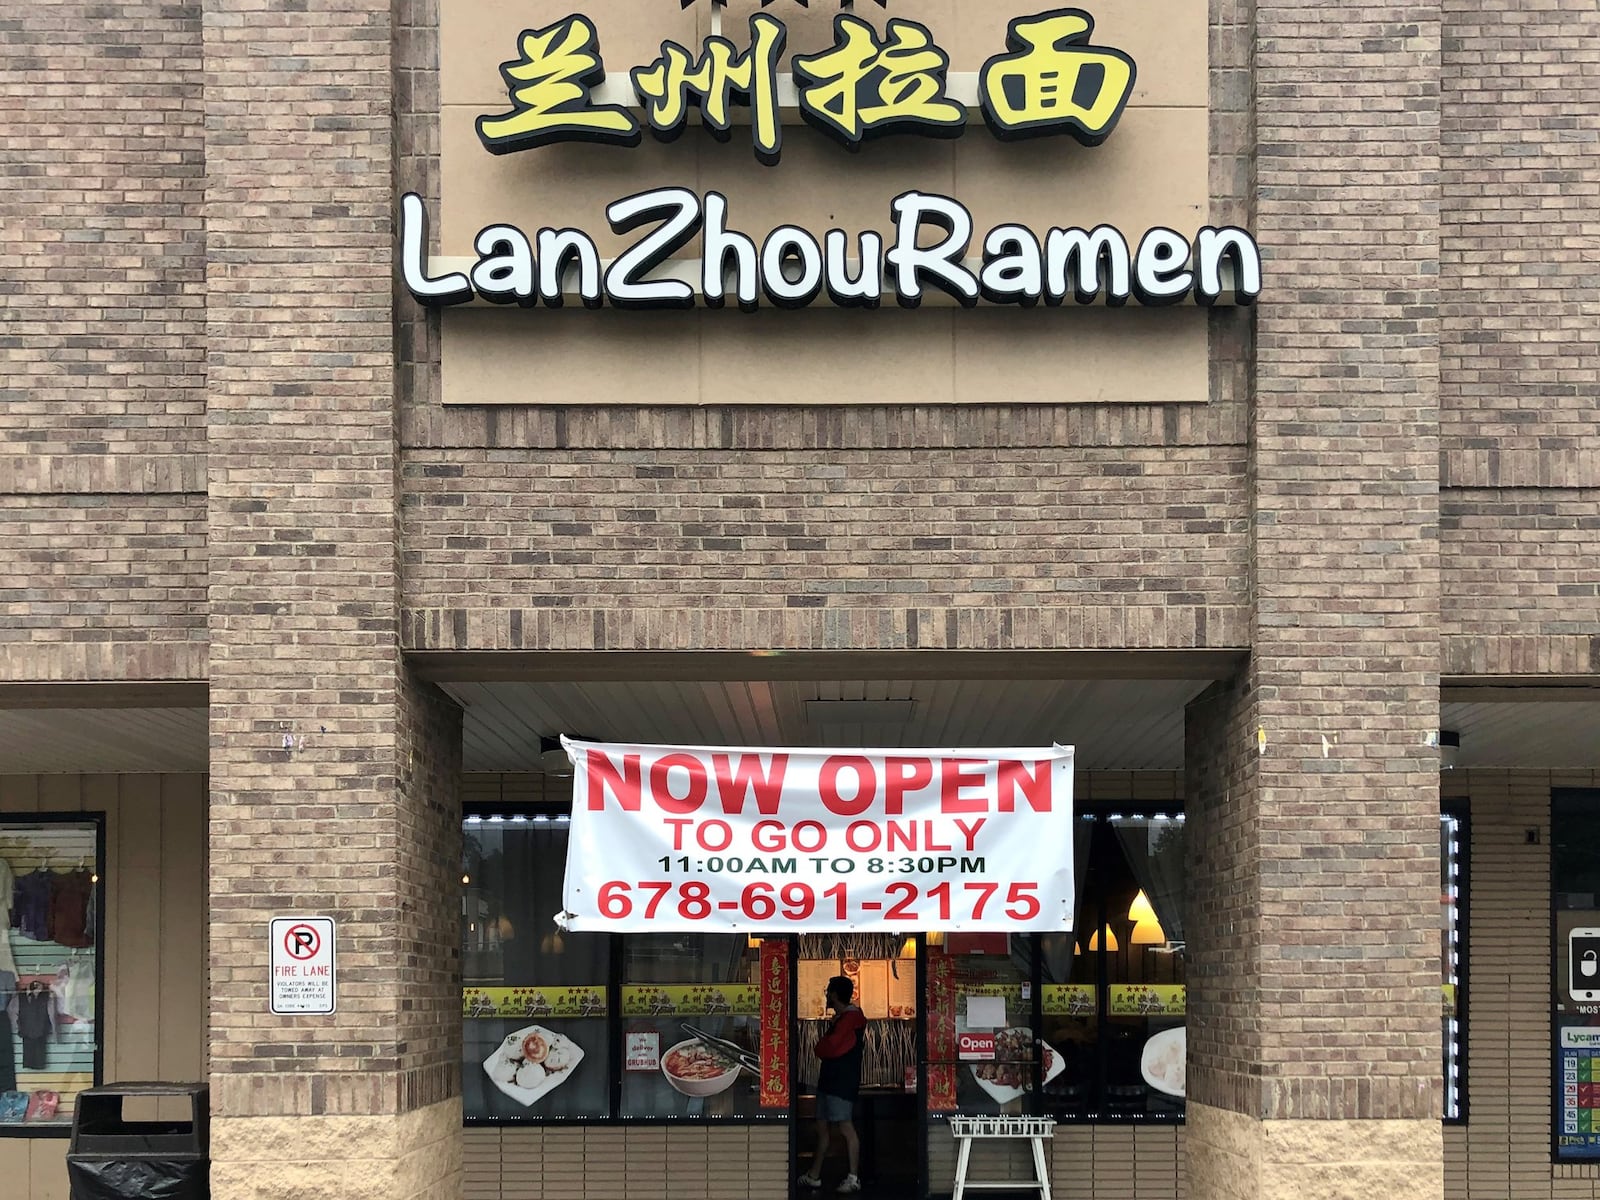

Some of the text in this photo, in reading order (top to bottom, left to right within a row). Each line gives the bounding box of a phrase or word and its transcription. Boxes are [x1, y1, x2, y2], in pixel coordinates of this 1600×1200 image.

[480, 12, 1133, 152] 兰州拉面
[402, 189, 1262, 303] LanZhouRamen
[587, 749, 1052, 816] NOW OPEN
[664, 818, 985, 853] TO GO ONLY
[659, 856, 984, 873] 11:00AM TO 8:30PM
[598, 881, 1040, 920] 678-691-2175
[275, 966, 330, 976] FIRE LANE
[1576, 1006, 1600, 1014] MOS
[960, 1037, 993, 1051] Open
